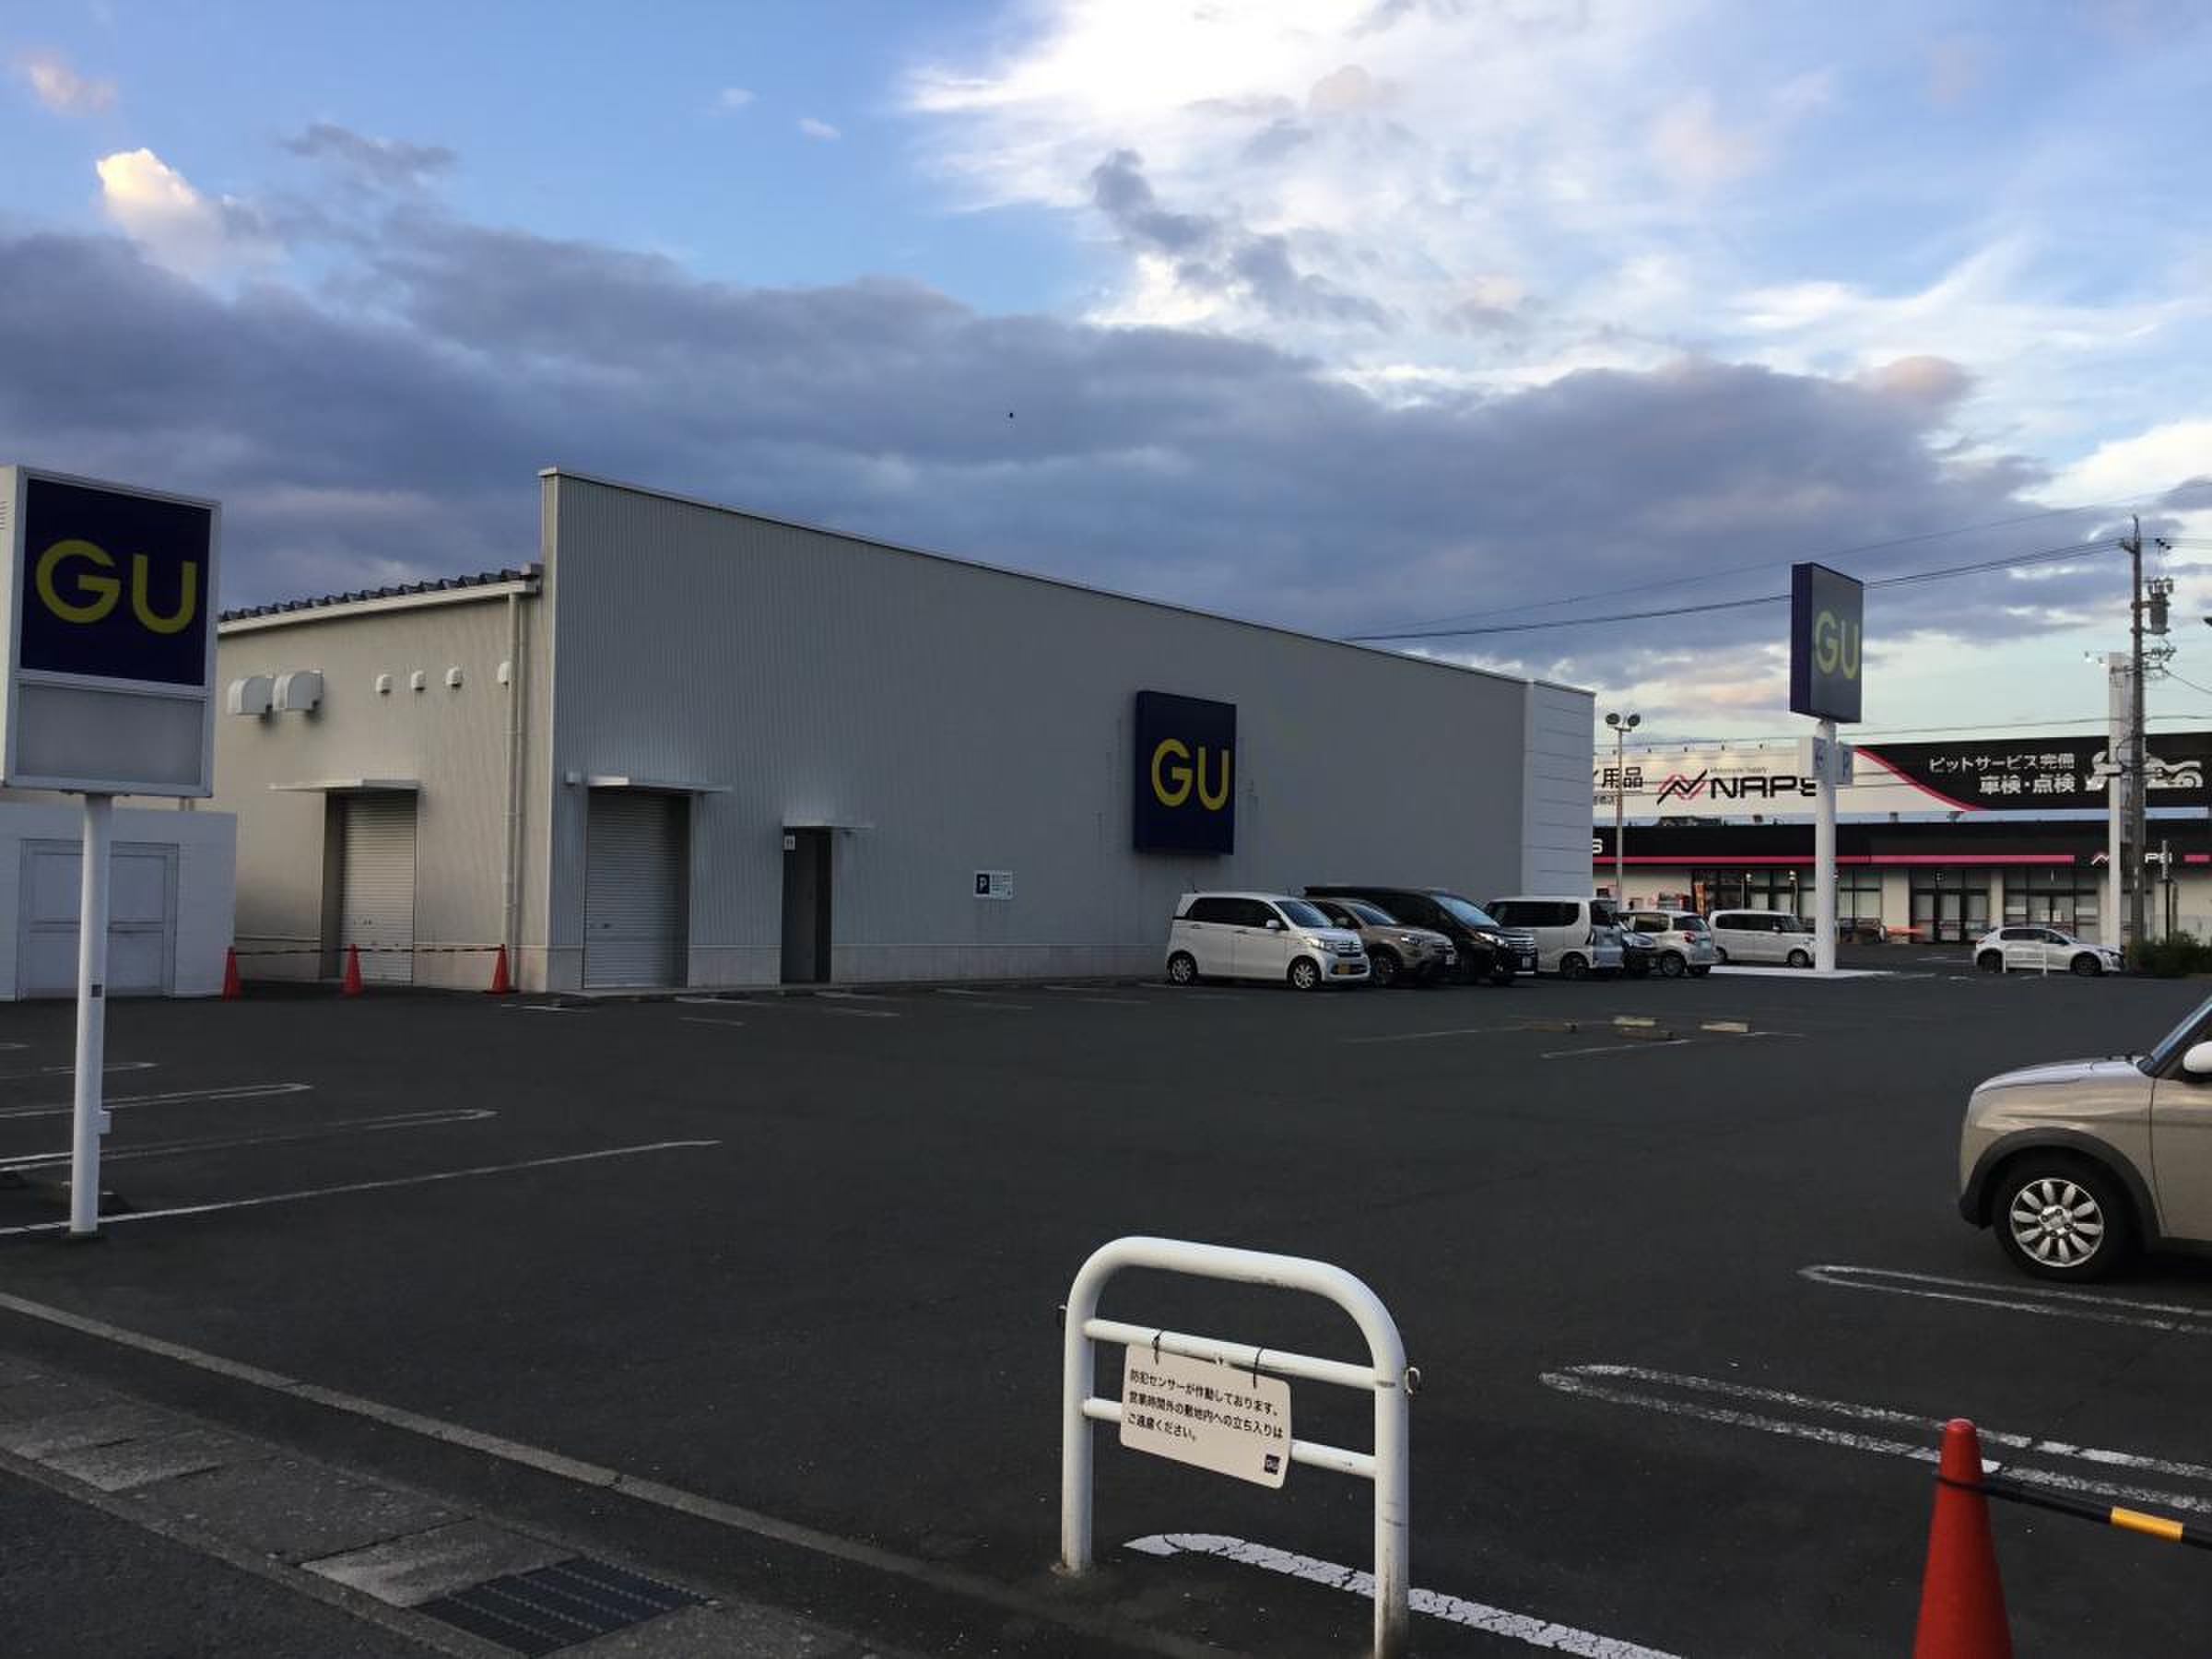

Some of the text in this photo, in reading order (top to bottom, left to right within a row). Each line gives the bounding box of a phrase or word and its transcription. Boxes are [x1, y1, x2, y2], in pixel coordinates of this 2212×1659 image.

[36, 539, 197, 633] GU
[1815, 609, 1859, 678] GU
[1151, 738, 1230, 811] GU
[1593, 766, 1643, 789] 用品
[1930, 753, 2075, 772] ピットサービス完備
[1979, 773, 2076, 794] 車検・点検
